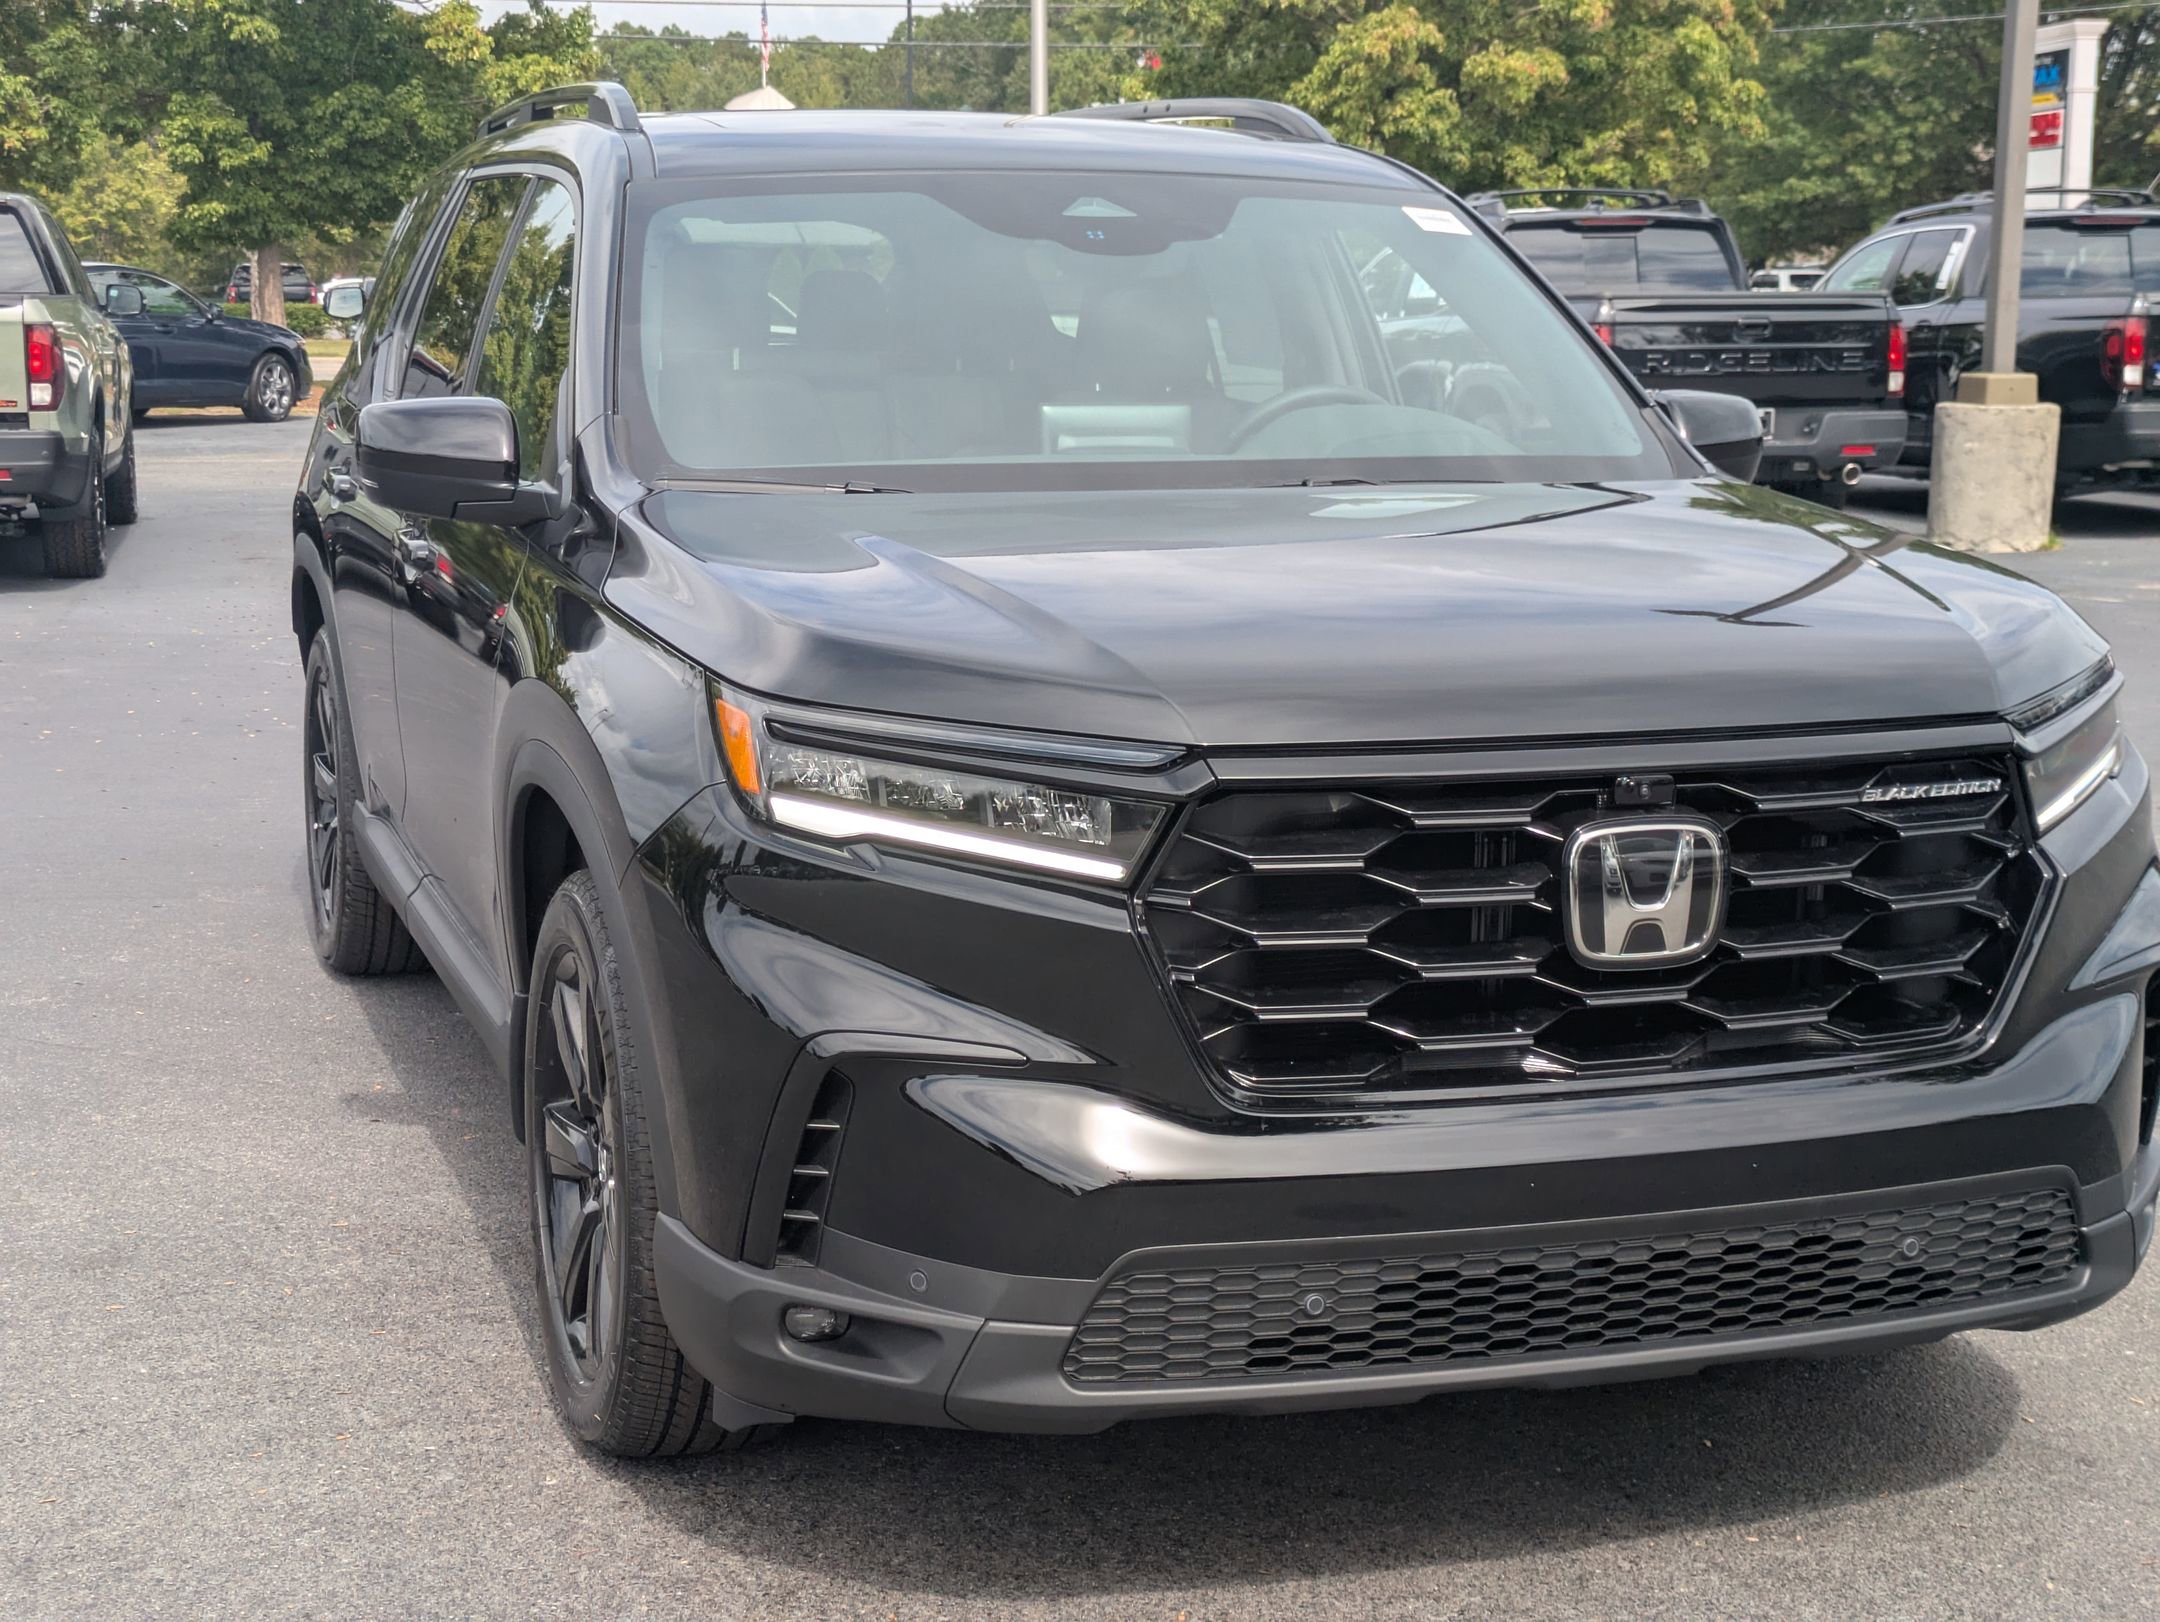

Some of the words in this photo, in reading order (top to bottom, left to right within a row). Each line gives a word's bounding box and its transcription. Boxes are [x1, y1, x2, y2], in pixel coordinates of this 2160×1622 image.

[1641, 352, 1865, 373] RIDGELINE
[1862, 785, 1929, 802] BLACK
[1930, 778, 2001, 797] EDITION
